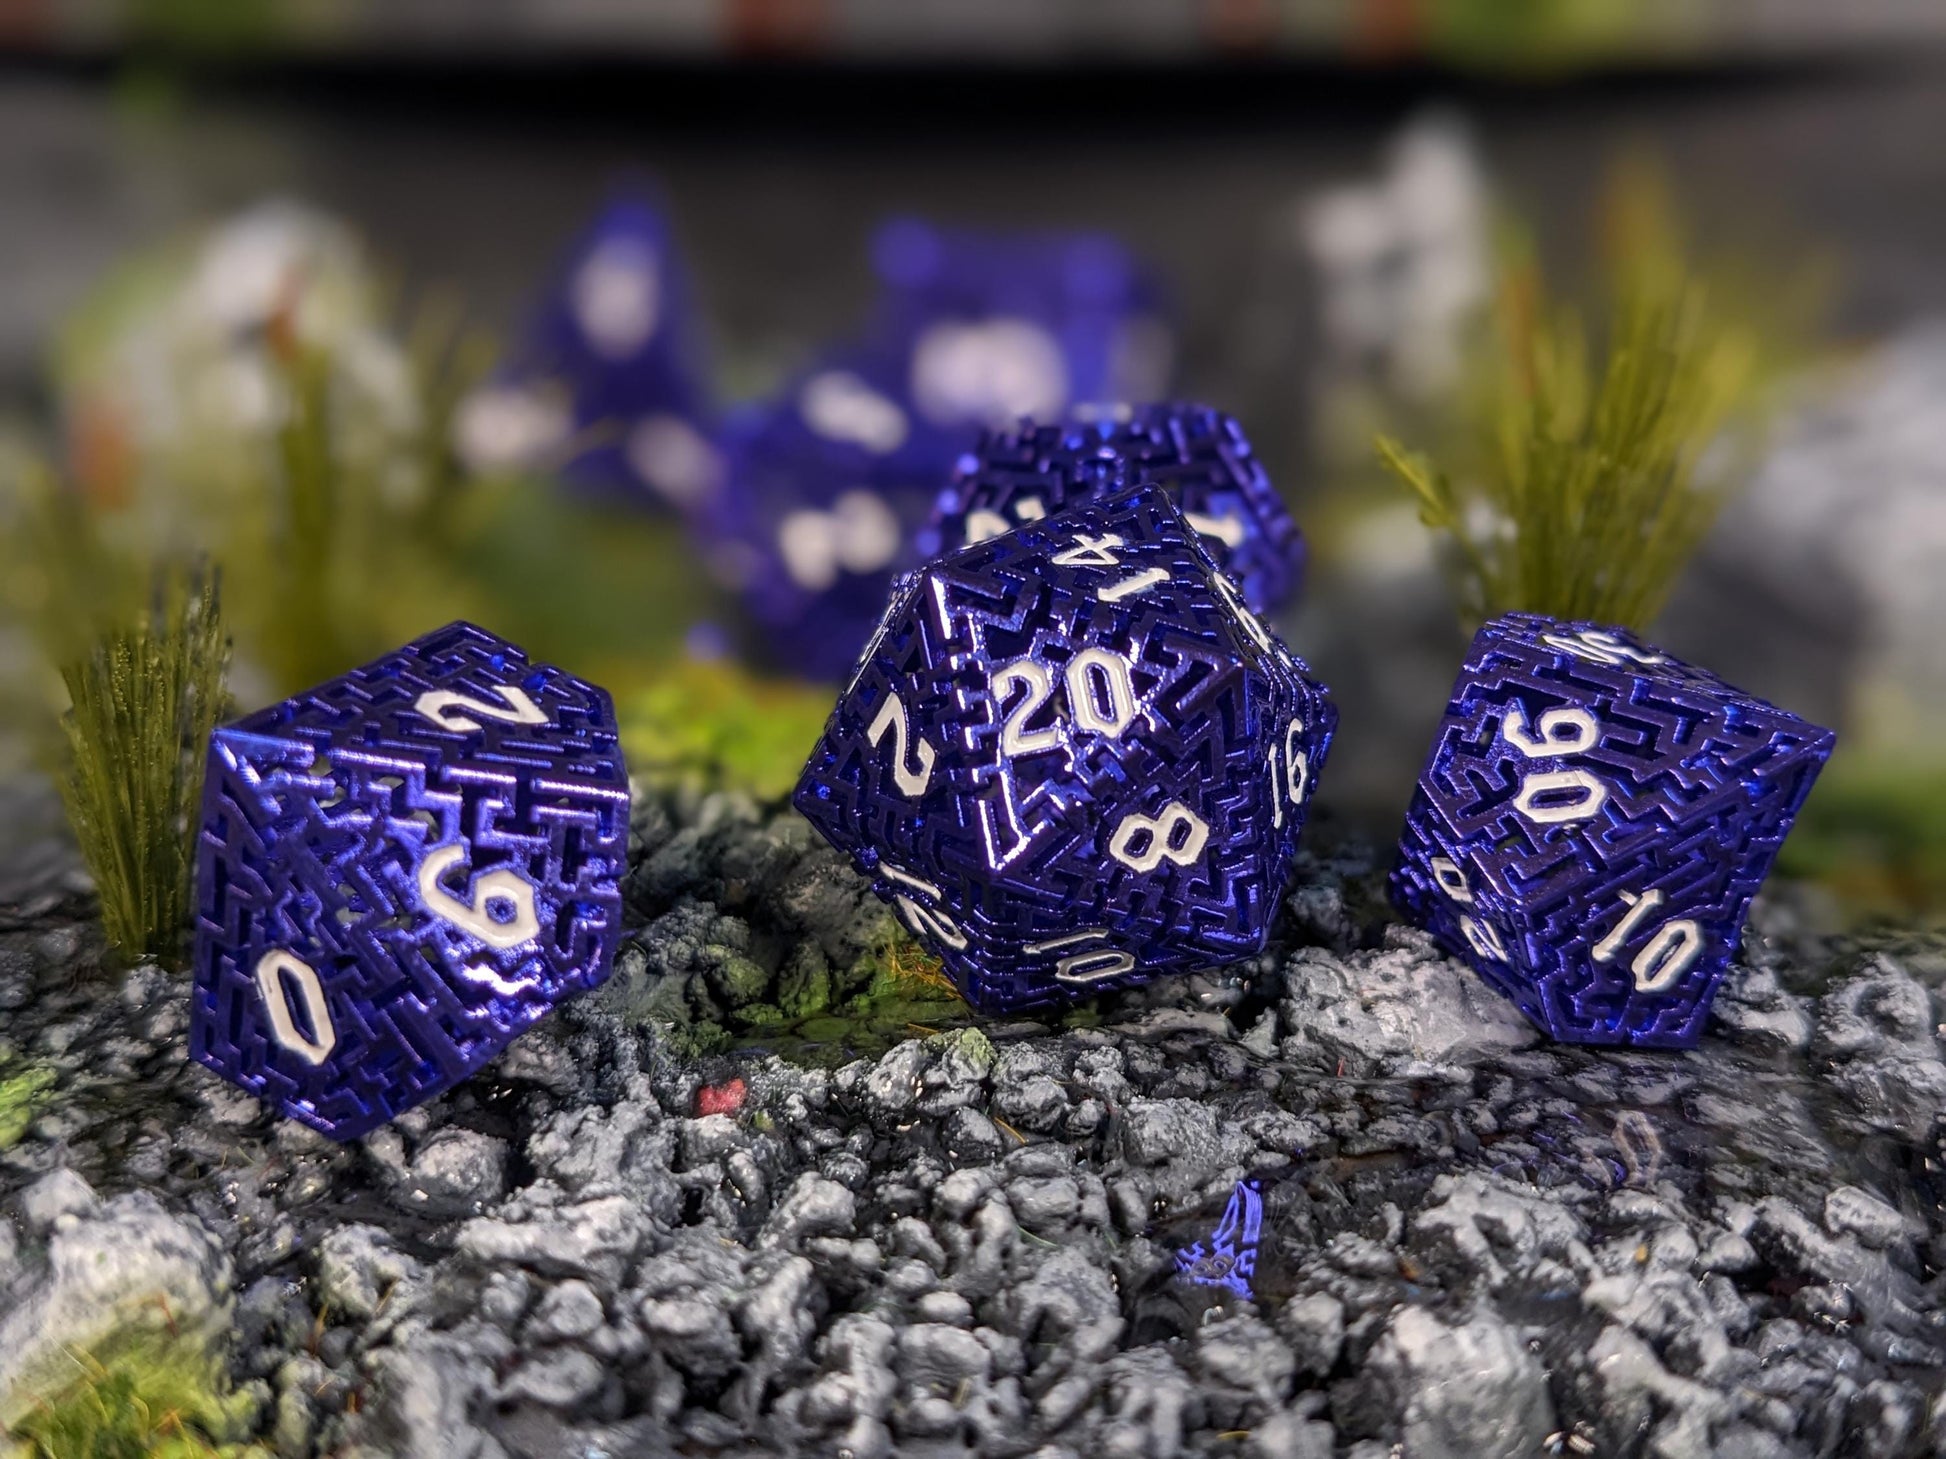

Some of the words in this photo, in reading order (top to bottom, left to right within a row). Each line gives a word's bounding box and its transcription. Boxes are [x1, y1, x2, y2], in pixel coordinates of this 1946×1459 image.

[1052, 533, 1170, 602] 14
[414, 685, 549, 732] 2
[868, 693, 935, 796] 2
[991, 648, 1135, 756] 20
[1268, 718, 1307, 829] 16
[1503, 708, 1606, 823] 90
[1110, 803, 1209, 873] 8
[418, 844, 540, 950] 6
[880, 861, 968, 950] 12
[1592, 889, 1699, 992] 10
[1022, 928, 1135, 982] 10
[256, 948, 336, 1066] 0
